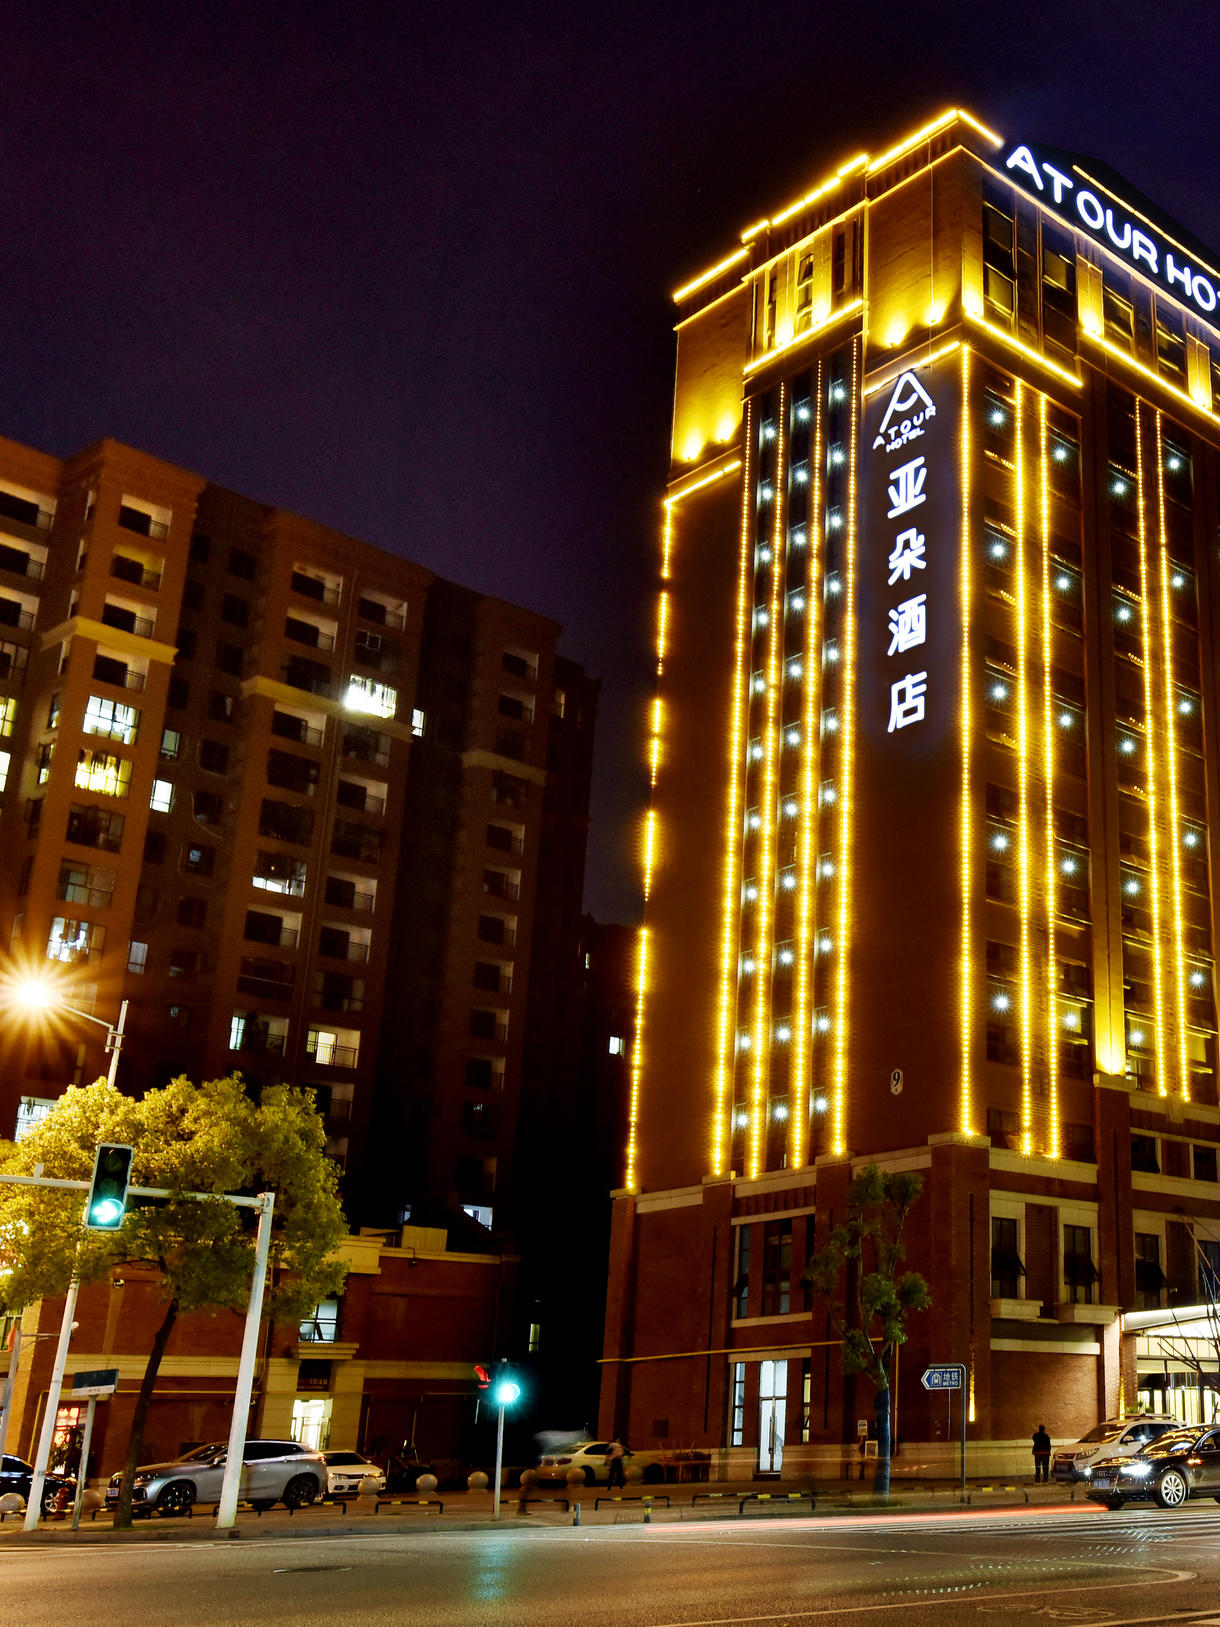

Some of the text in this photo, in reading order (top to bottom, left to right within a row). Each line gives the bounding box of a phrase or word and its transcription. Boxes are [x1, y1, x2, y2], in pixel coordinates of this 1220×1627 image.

[1007, 145, 1159, 273] ATOUR
[872, 405, 936, 450] ATOUR
[886, 427, 925, 452] HOTEL
[888, 456, 927, 733] 亚朵酒店
